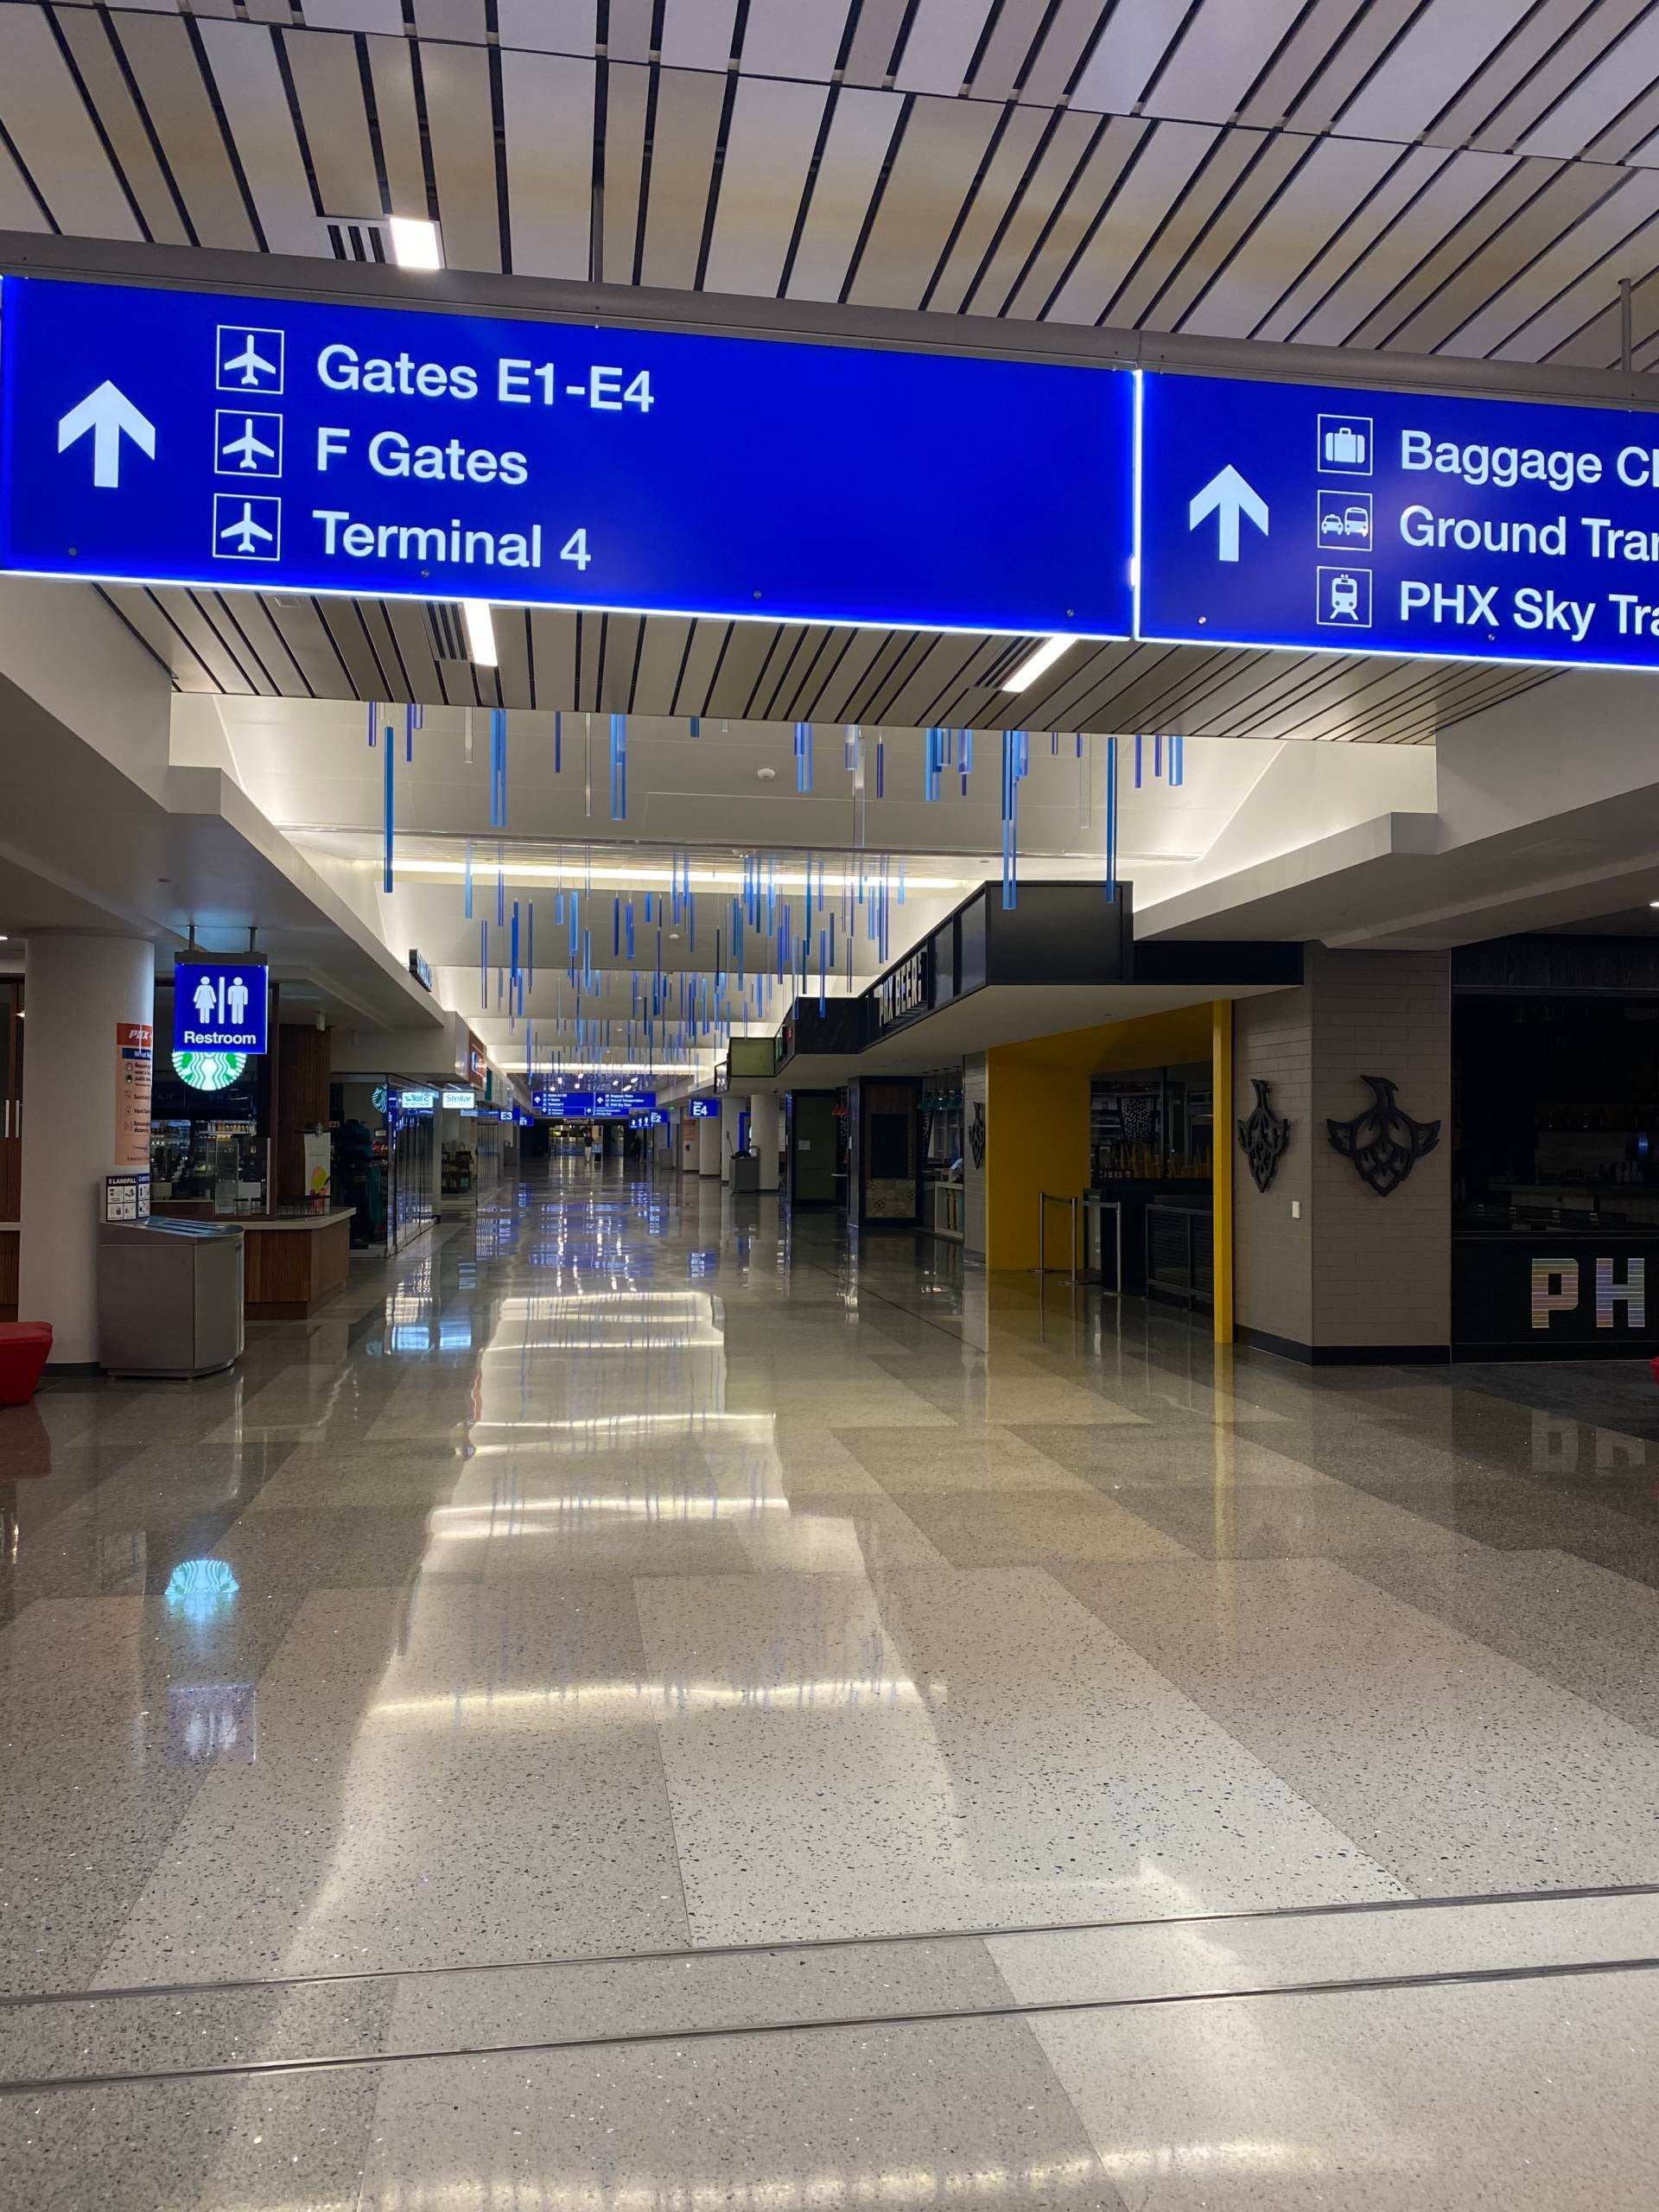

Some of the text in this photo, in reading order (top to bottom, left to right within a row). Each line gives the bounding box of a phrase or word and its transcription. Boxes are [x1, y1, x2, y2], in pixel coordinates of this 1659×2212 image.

[317, 344, 655, 413] Gates E1-E4
[317, 427, 528, 485] F Gates
[1402, 429, 1604, 493] Baggage
[312, 510, 592, 571] Terminal 4
[1401, 505, 1659, 562] Ground Tra
[1401, 580, 1500, 626] PHX
[1512, 588, 1596, 642] Sky
[184, 1031, 257, 1045] Restroom
[446, 1094, 471, 1103] Stellar
[500, 1111, 513, 1121] E3
[651, 1115, 662, 1123] E2
[693, 1105, 708, 1116] E4
